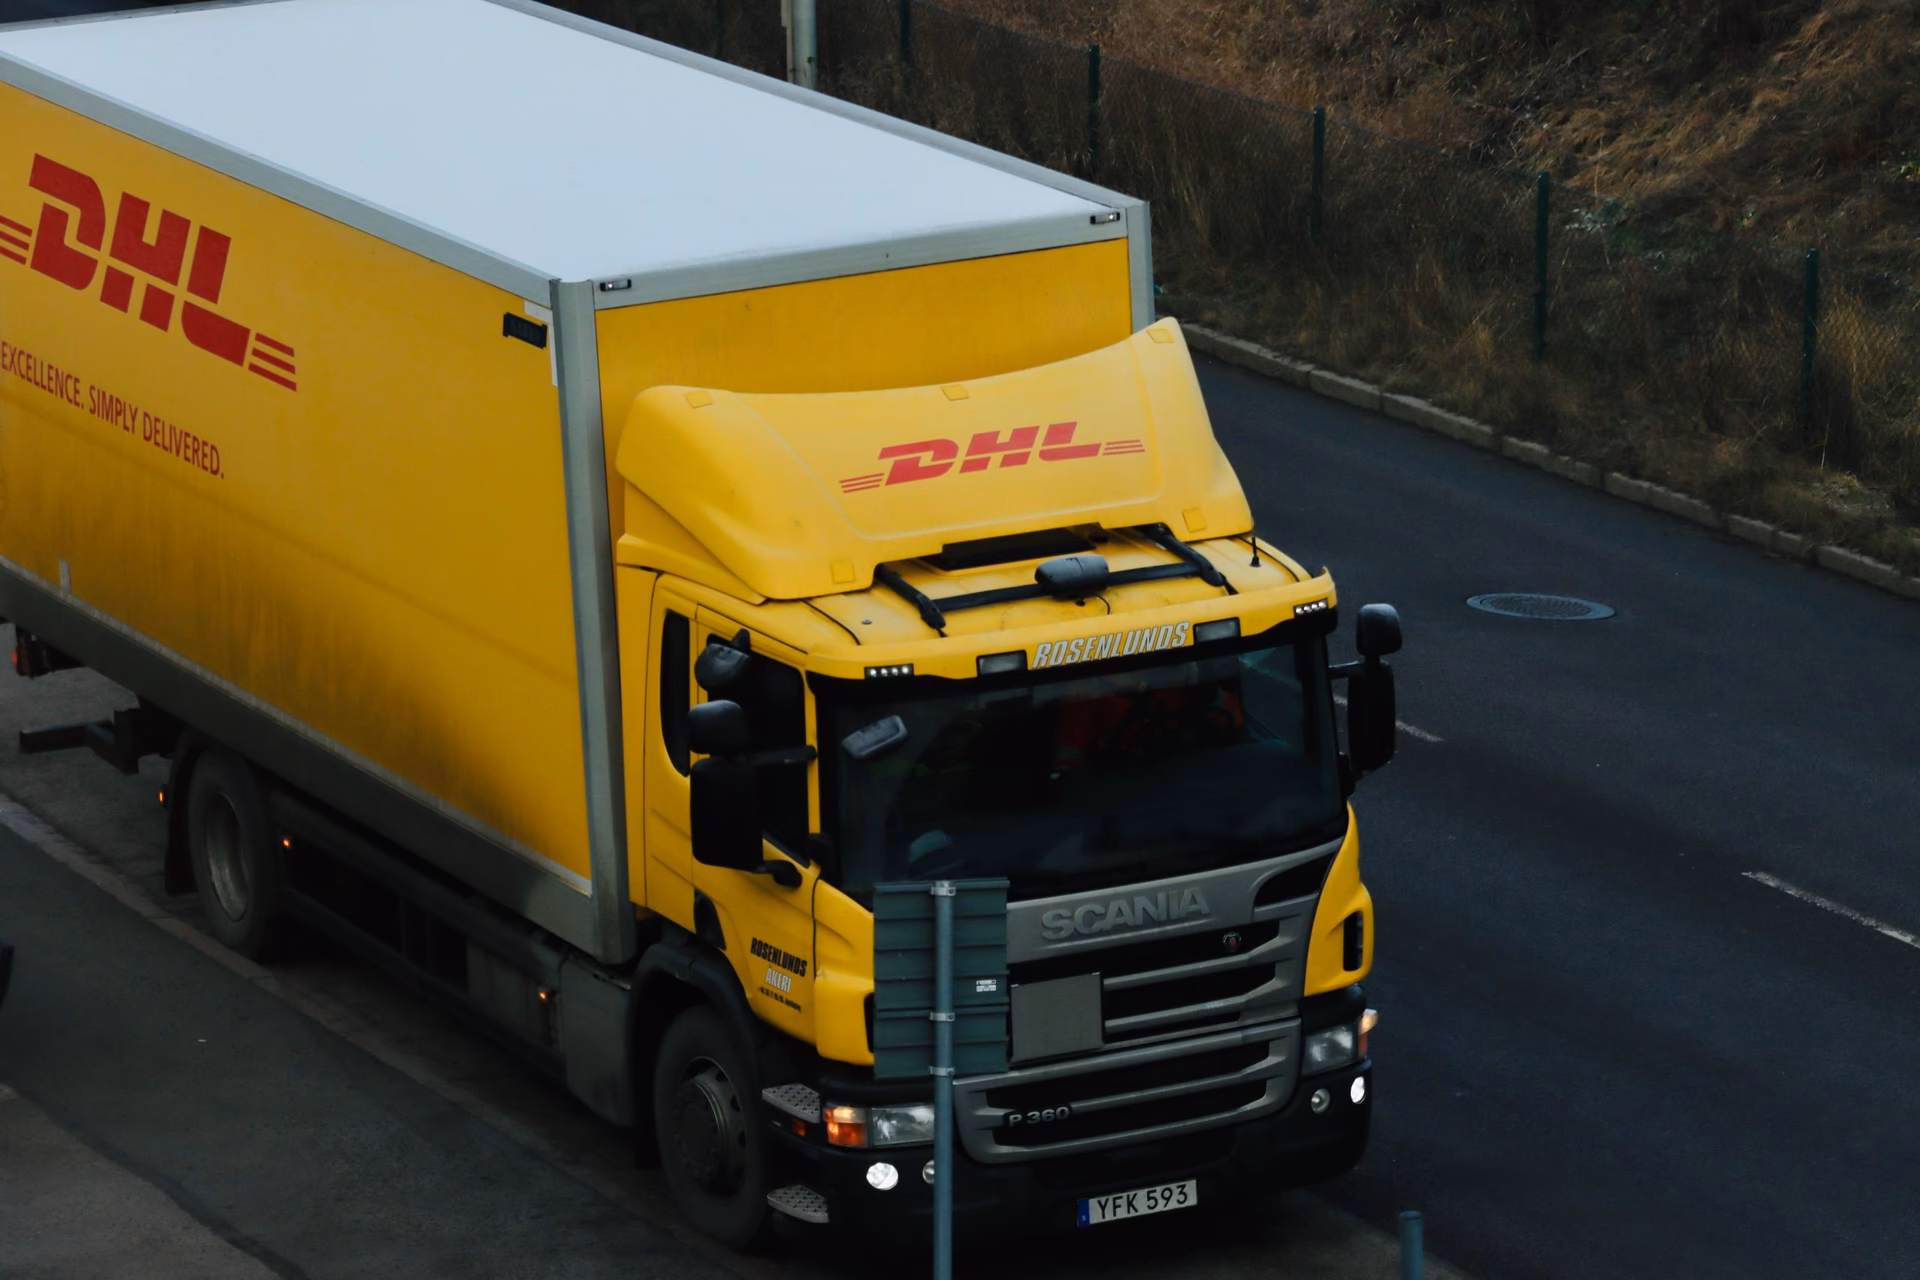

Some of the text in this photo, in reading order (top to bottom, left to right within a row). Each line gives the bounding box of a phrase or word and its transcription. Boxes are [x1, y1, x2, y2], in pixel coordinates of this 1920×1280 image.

[28, 153, 251, 367] DHL
[1, 340, 224, 479] EXCELLENCE. SIMPLY DELIVERED.
[878, 421, 1101, 486] DHL
[1031, 622, 1191, 669] ROSENLUNDS
[1041, 887, 1210, 940] SCANIA
[750, 937, 807, 977] ROSENLUNDS
[1008, 1105, 1070, 1127] P 360
[1097, 1184, 1188, 1219] YFK 593
